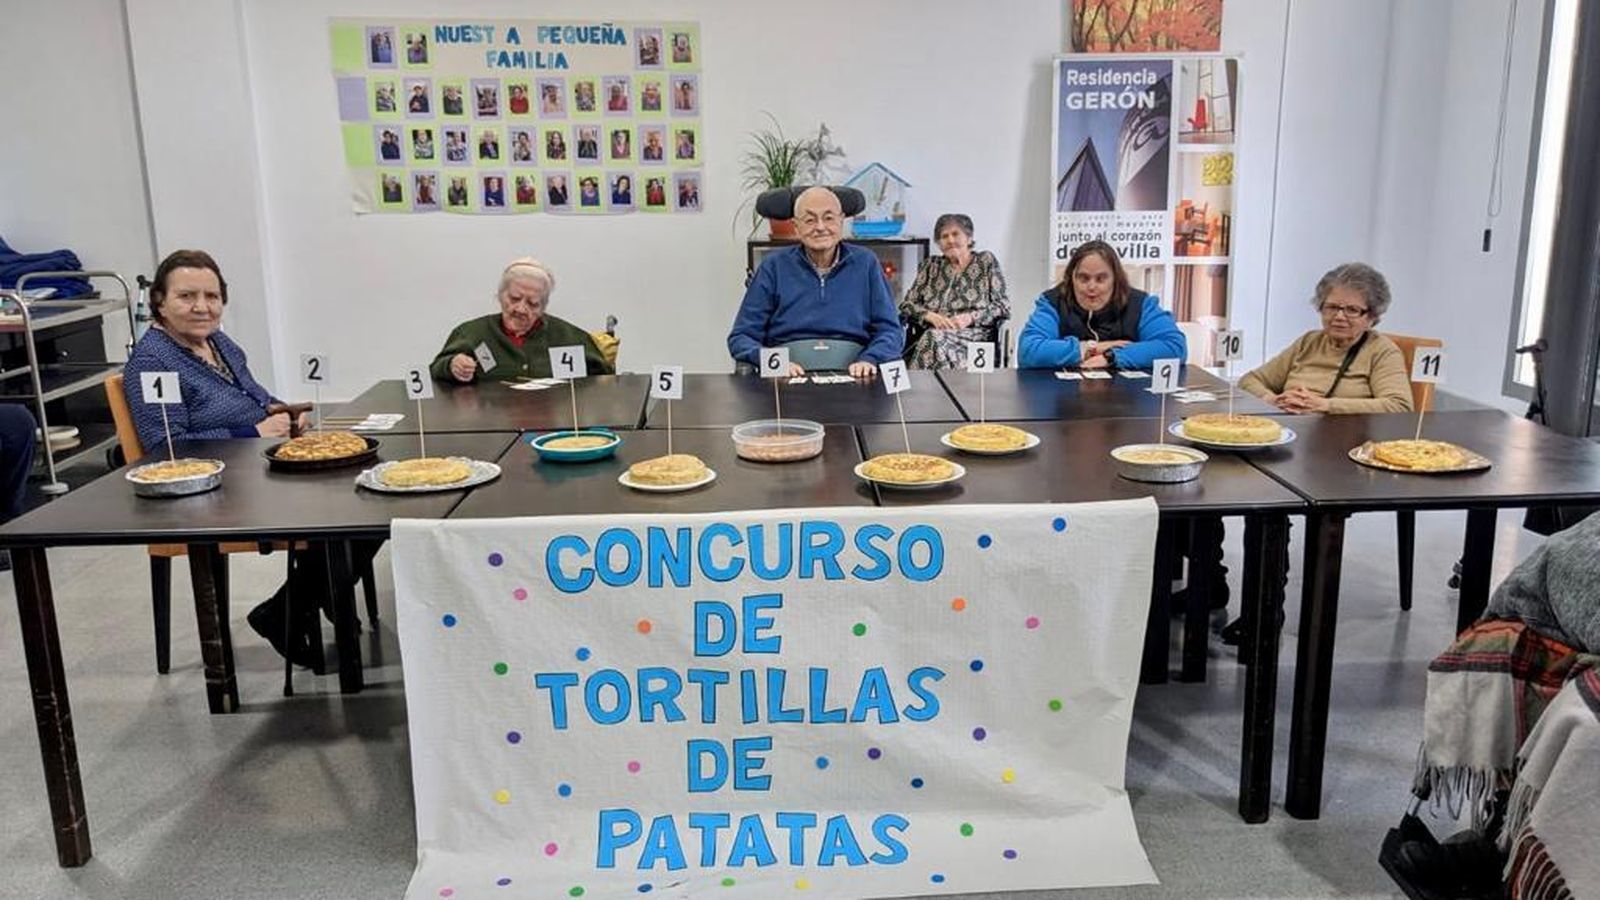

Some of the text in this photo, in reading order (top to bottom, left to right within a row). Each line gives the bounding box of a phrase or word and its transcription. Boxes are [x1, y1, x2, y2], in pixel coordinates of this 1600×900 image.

[537, 22, 627, 45] PEQUEÑA
[486, 50, 569, 69] FAMILIA
[1066, 69, 1158, 86] Residencia
[1066, 87, 1156, 110] GERÓN
[1057, 231, 1092, 244] junto
[1110, 229, 1163, 242] corazón
[1222, 334, 1240, 358] 10
[307, 358, 323, 380] 2
[561, 352, 574, 372] 4
[768, 352, 781, 370] 6
[973, 348, 986, 368] 8
[1421, 354, 1441, 376] 11
[152, 376, 163, 399] 1
[410, 370, 423, 393] 3
[659, 372, 674, 391] 5
[888, 367, 900, 387] 7
[1160, 364, 1172, 389] 9
[545, 521, 945, 593] CONCURSO
[693, 593, 783, 657] DE
[535, 666, 947, 729] TORTILLAS
[687, 736, 773, 792] DE
[596, 808, 910, 870] PATATAS
